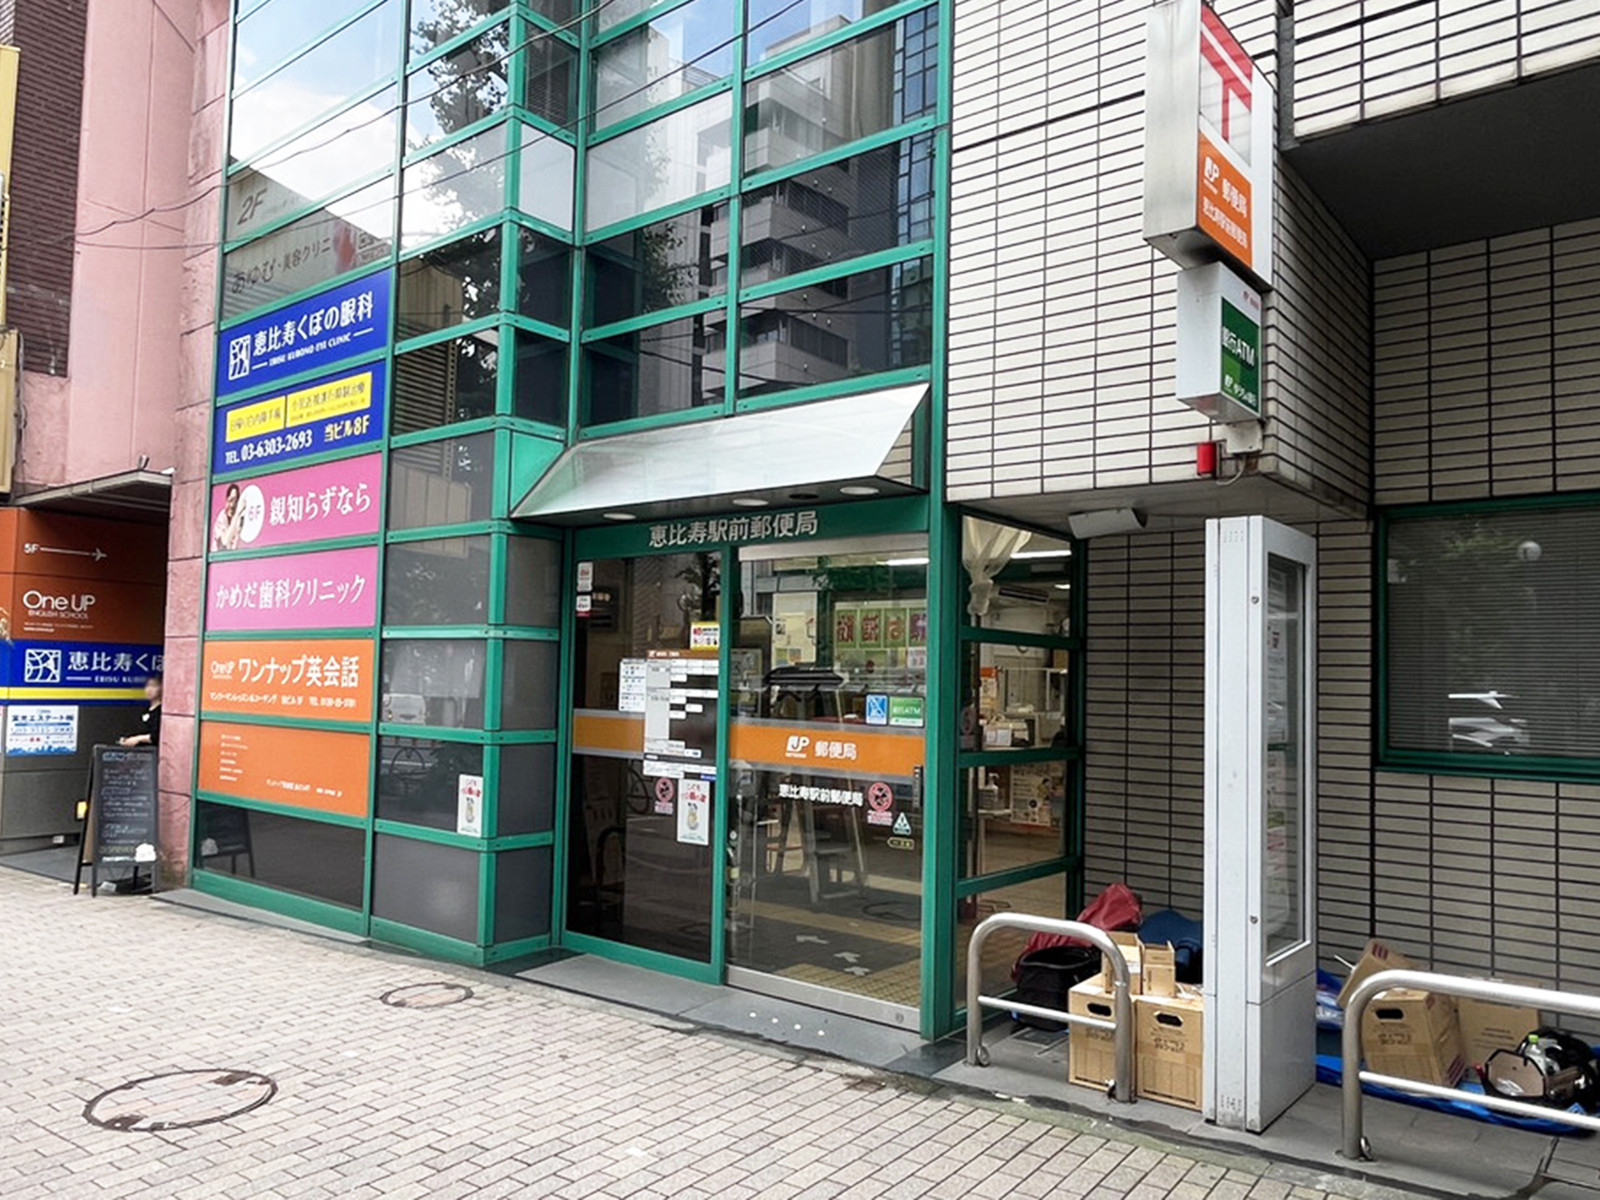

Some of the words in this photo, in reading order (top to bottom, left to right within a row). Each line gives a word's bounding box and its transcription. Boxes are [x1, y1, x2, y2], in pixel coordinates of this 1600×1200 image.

[237, 188, 268, 226] 2F
[240, 428, 313, 461] 03-6303-2693
[269, 482, 371, 526] 親知らずなら
[649, 510, 819, 548] 恵比寿駅前郵便局
[215, 574, 366, 610] かめだ歯科クリニック
[238, 653, 360, 688] ワンナップ英会話
[815, 741, 857, 761] 郵便局
[778, 784, 864, 807] 恵比寿駅前郵便局
